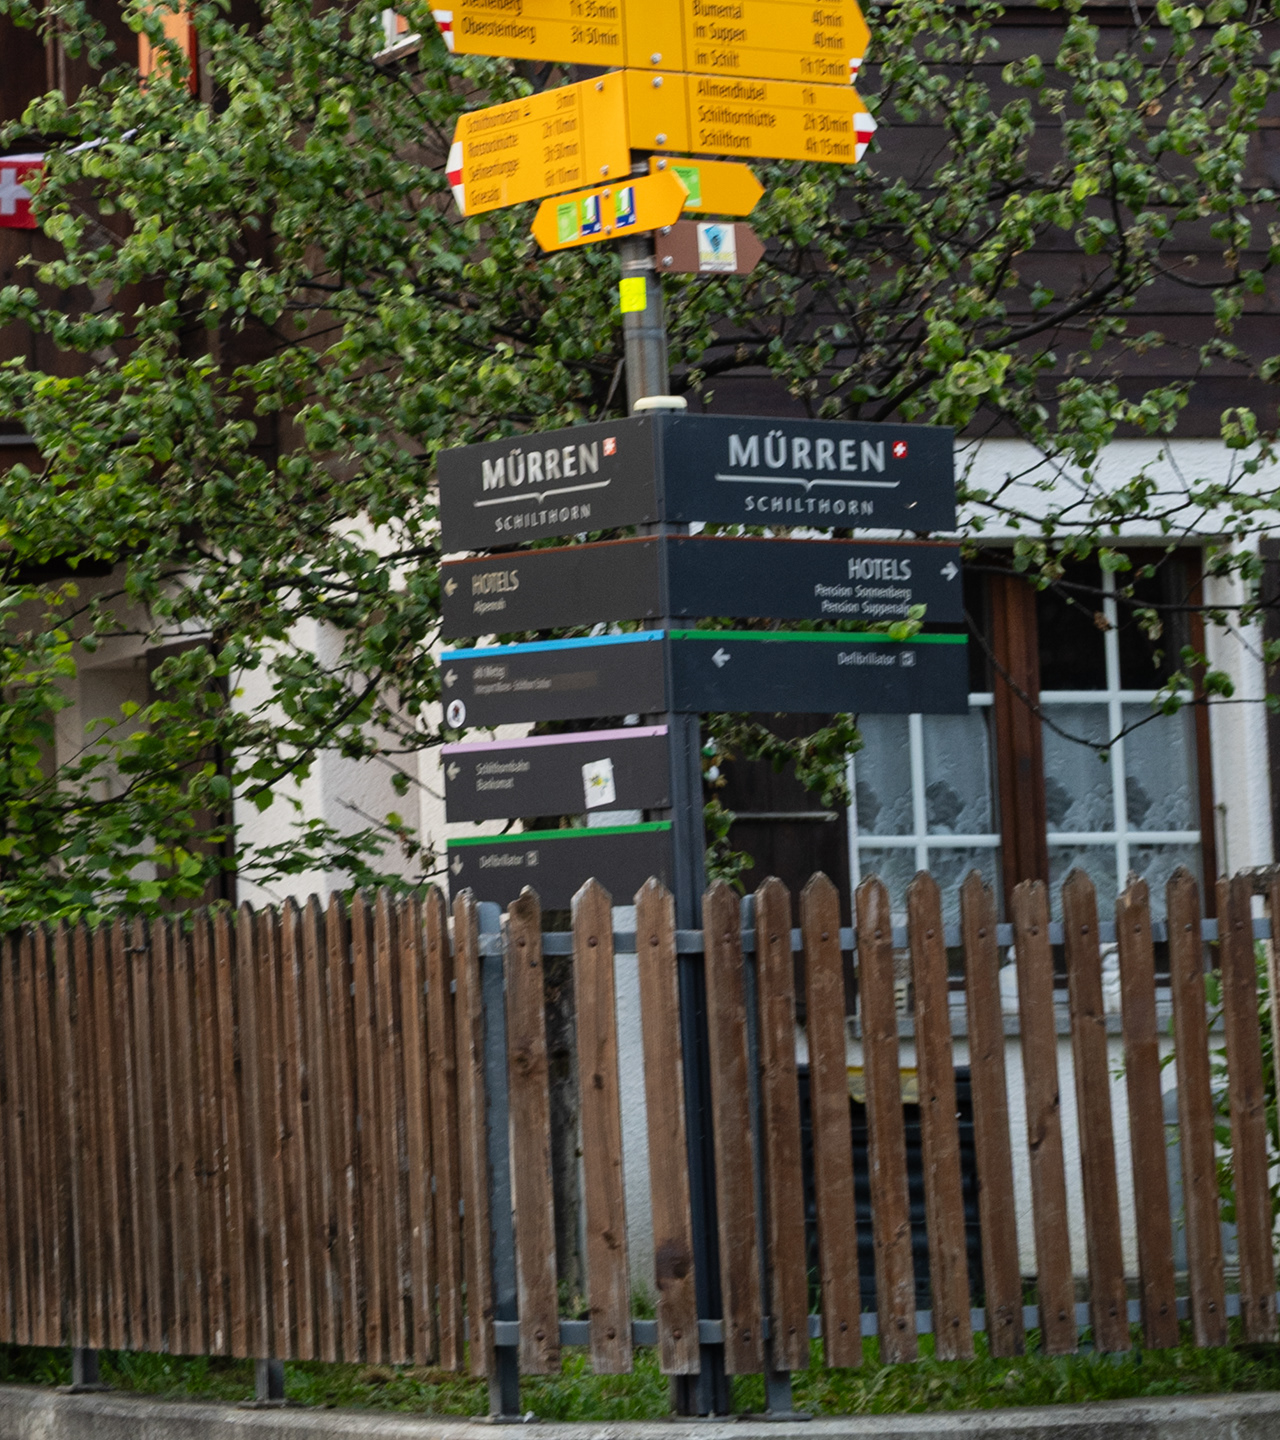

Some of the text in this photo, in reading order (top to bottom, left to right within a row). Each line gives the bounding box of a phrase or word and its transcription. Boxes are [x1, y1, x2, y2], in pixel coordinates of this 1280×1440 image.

[461, 17, 536, 44] Obersteinberg
[709, 22, 747, 46] Suppen
[711, 49, 740, 68] Schilt
[698, 105, 776, 128] Schilthornhütte
[699, 129, 751, 148] Schilthorn
[585, 195, 596, 221] 1
[619, 187, 630, 213] 1
[728, 429, 886, 472] MÜRREN
[482, 441, 599, 491] MÜRREN
[744, 495, 874, 515] SCHILTHORN
[494, 503, 591, 533] SCHILTHORN
[848, 557, 912, 581] HOTELS
[471, 570, 520, 596] HOTELS
[815, 583, 912, 601] Pension Sonnenberg
[821, 600, 860, 614] Pension
[838, 651, 896, 665] Defibrillator
